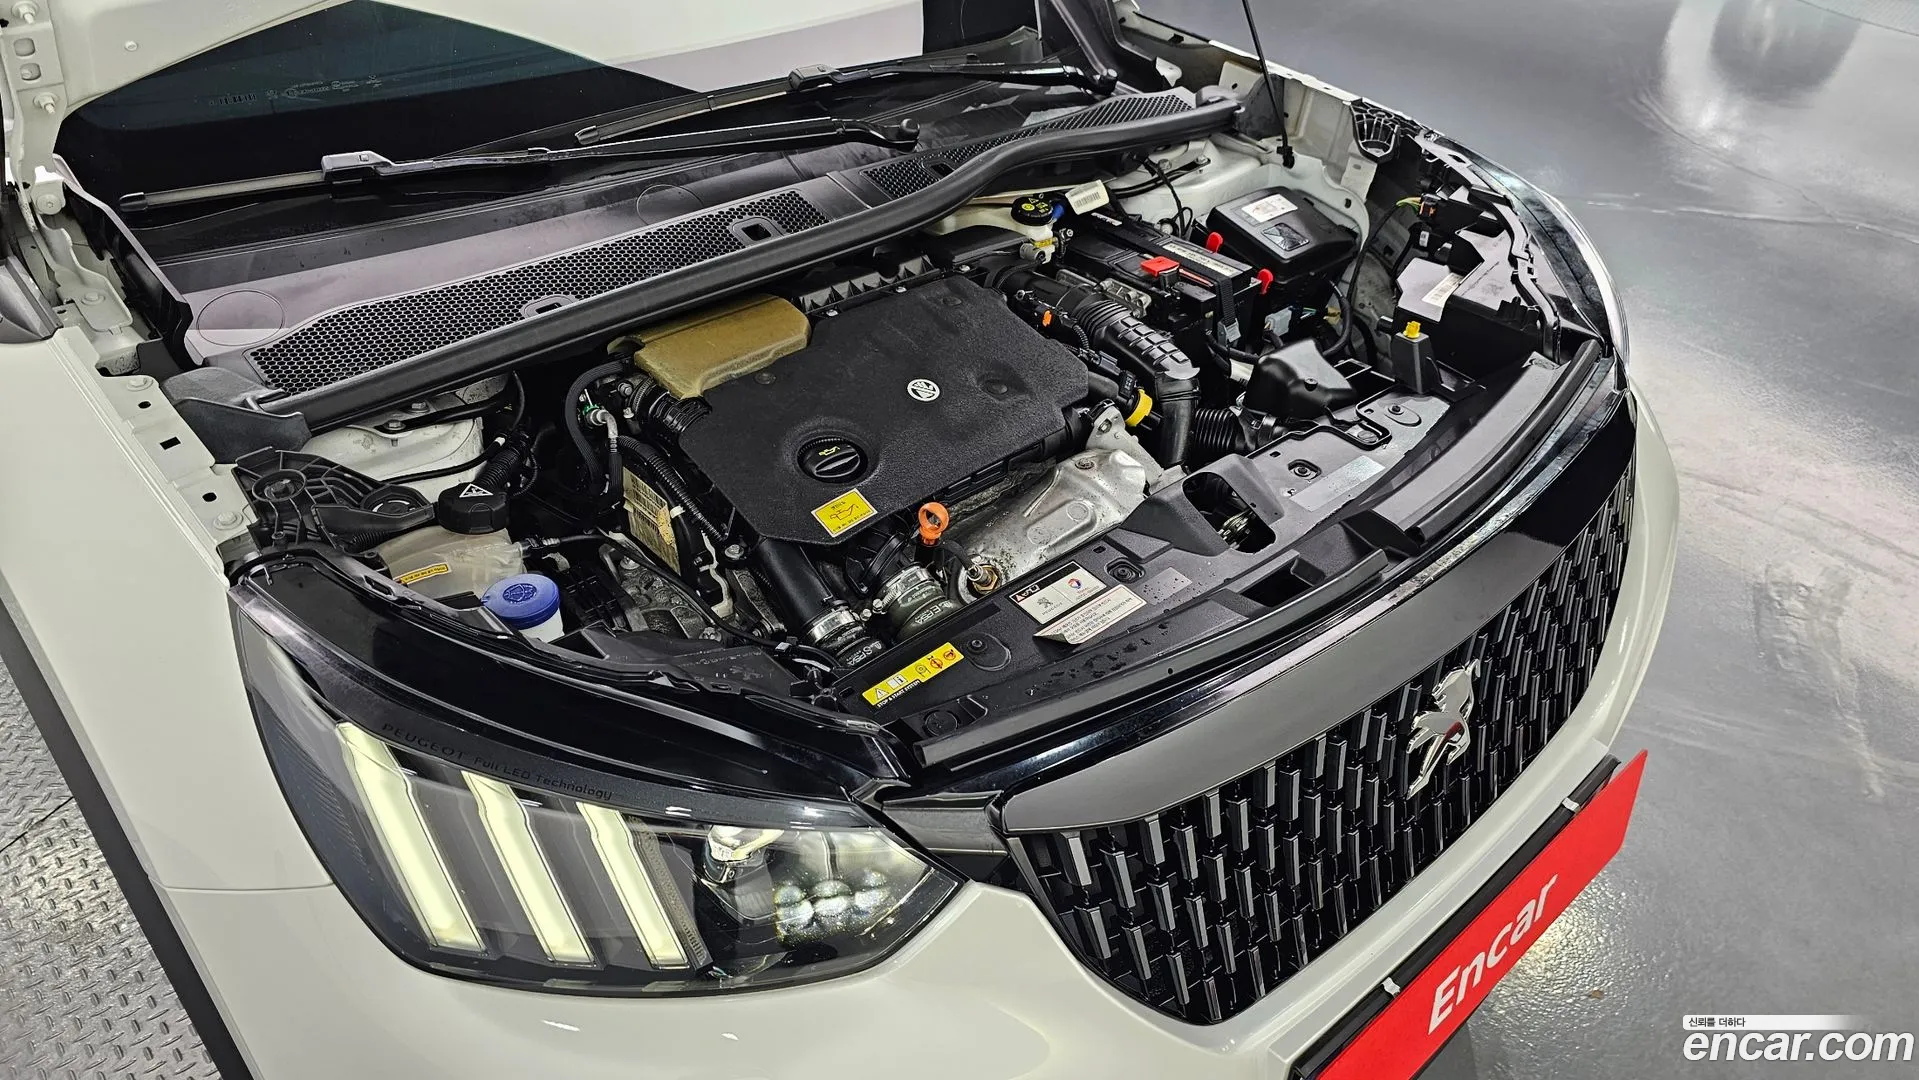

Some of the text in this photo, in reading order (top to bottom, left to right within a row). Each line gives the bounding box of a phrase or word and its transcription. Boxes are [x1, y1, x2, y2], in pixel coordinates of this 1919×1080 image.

[877, 697, 889, 708] STOP
[892, 688, 905, 699] START
[905, 680, 920, 691] SYSTEM
[381, 723, 613, 801] PEUGEOT Full LED Technology
[1428, 874, 1558, 1035] Encar
